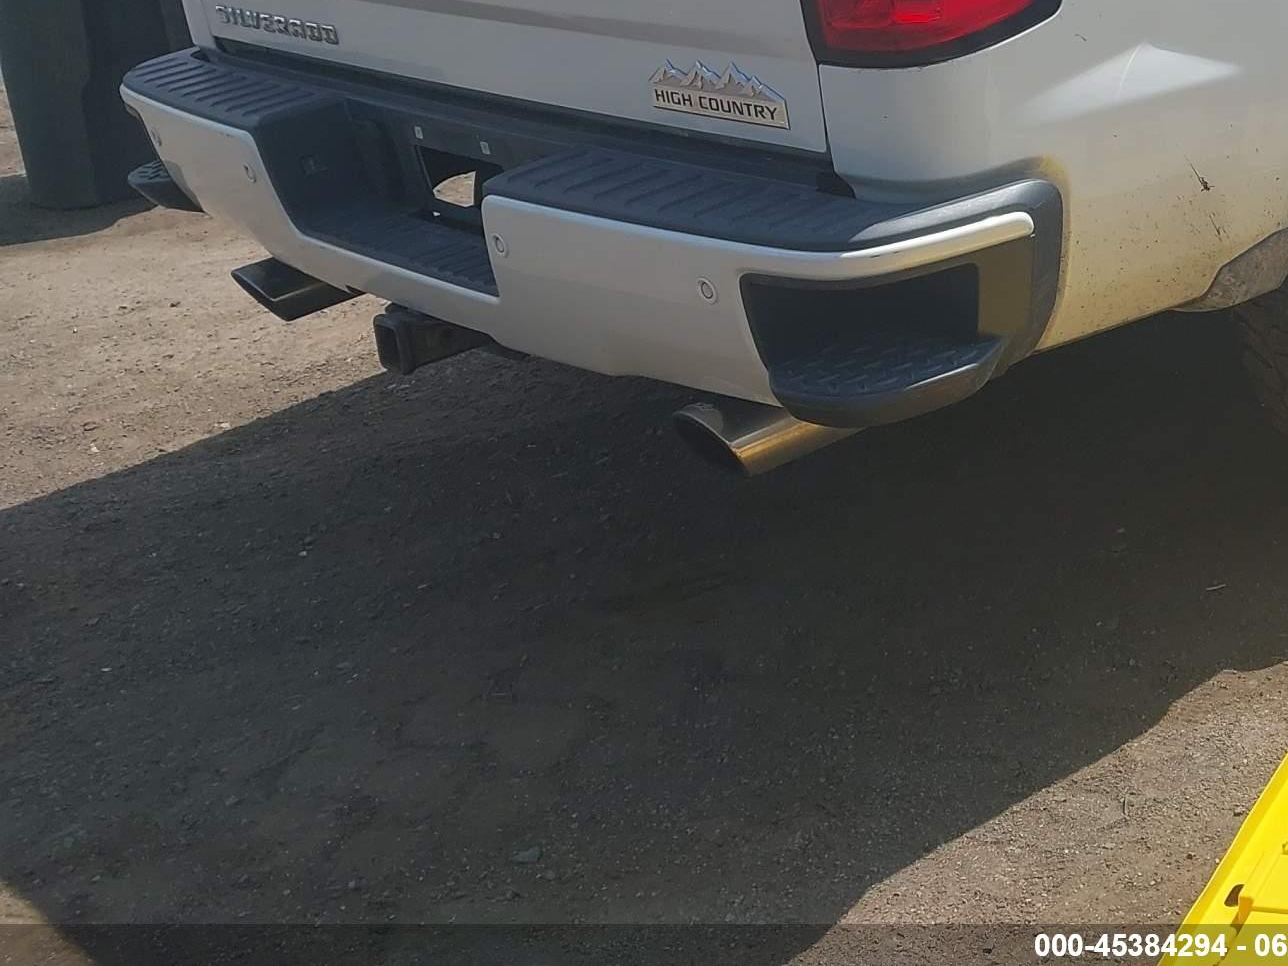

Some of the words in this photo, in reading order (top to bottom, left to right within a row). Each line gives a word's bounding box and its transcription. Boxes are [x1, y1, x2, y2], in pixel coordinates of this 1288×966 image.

[215, 4, 339, 45] SILVERADO
[654, 88, 693, 107] HIGH
[698, 96, 778, 121] COUNTRY
